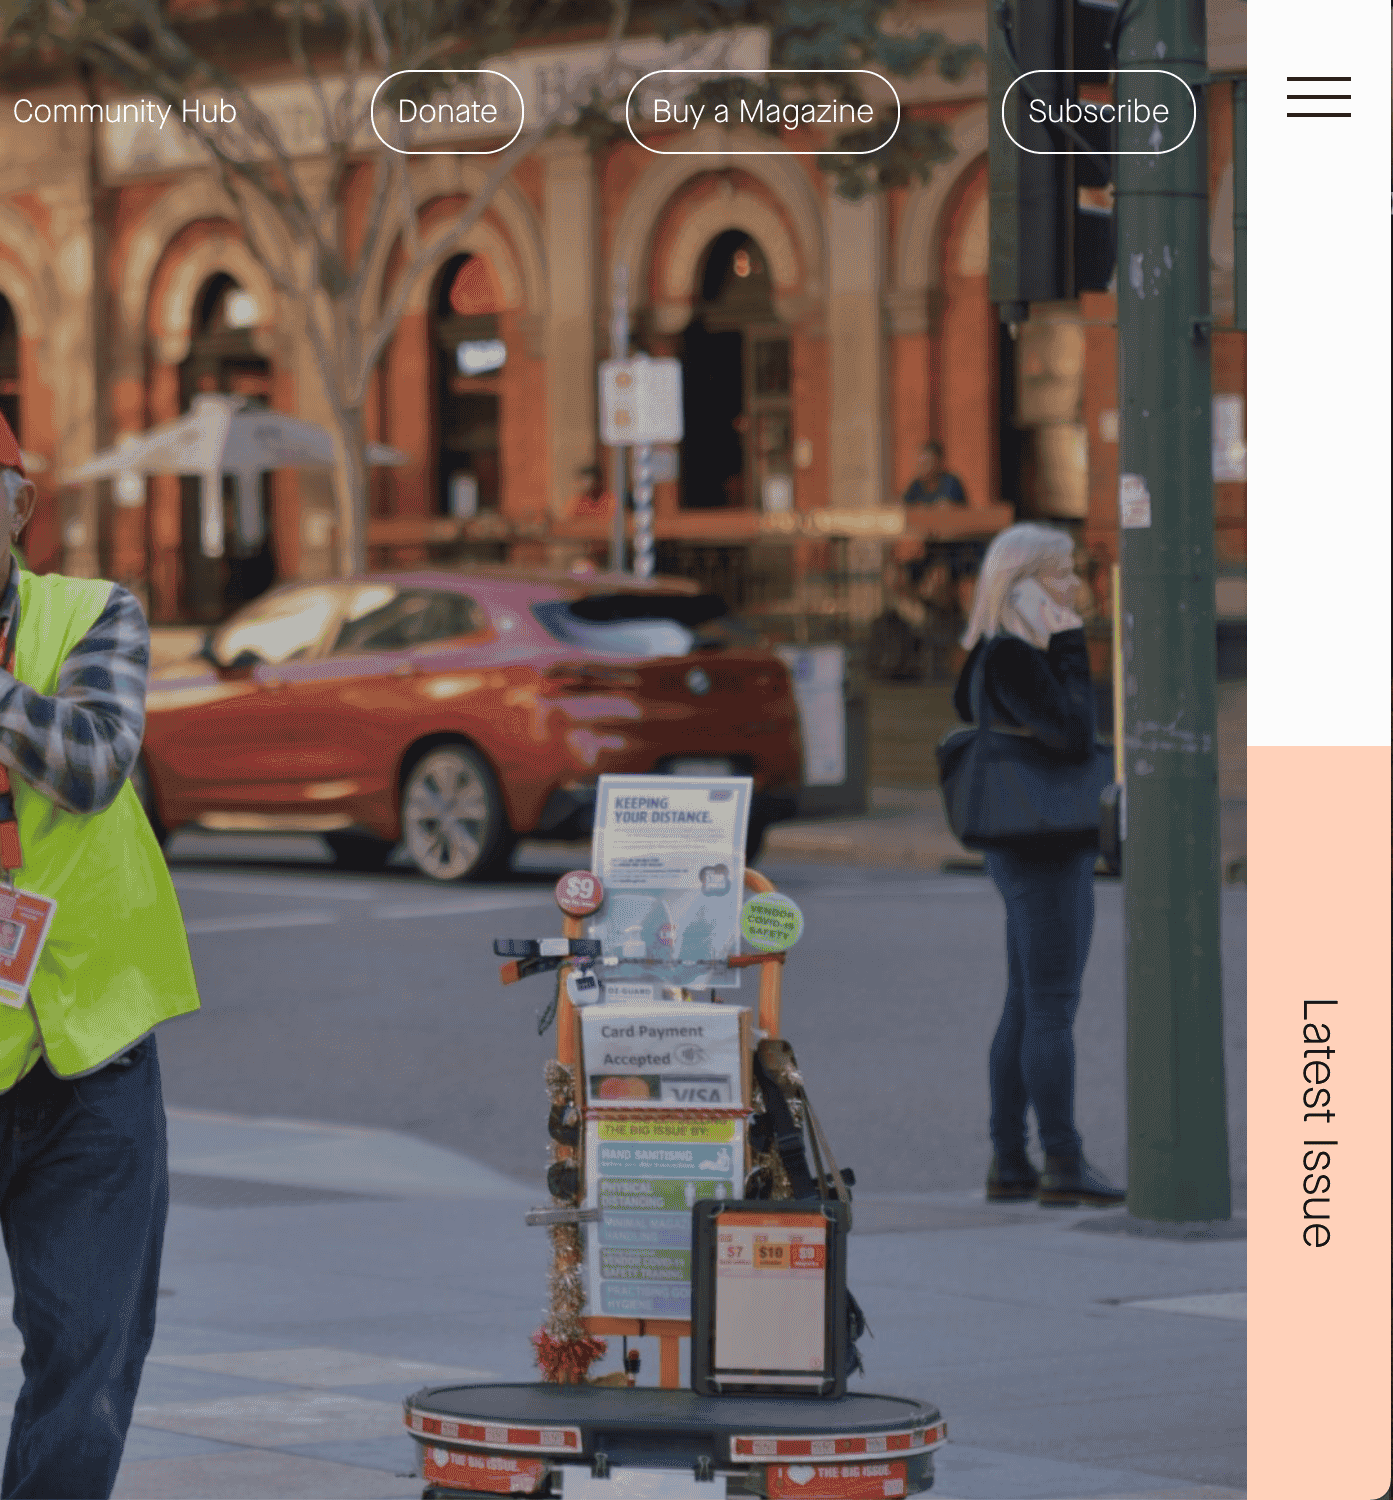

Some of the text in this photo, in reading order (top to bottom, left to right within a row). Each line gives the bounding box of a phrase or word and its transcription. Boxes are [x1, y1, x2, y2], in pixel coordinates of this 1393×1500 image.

[614, 797, 669, 810] KEEPING
[614, 810, 648, 823] YOUR
[566, 876, 594, 898] $9
[750, 904, 795, 921] VENDOR
[748, 926, 790, 941] SAFETY
[600, 1025, 704, 1041] Card Payment
[603, 1053, 671, 1068] Accepted
[670, 1088, 722, 1102] VISA
[604, 1124, 627, 1136] THE
[629, 1124, 651, 1136] BIG
[653, 1124, 688, 1137] ISSUE
[601, 1149, 632, 1160] HAND
[600, 1181, 652, 1193] PHYSICAL
[758, 1245, 784, 1259] $10
[450, 1452, 466, 1465] THE
[818, 1466, 839, 1478] THE
[840, 1466, 861, 1478] BIG
